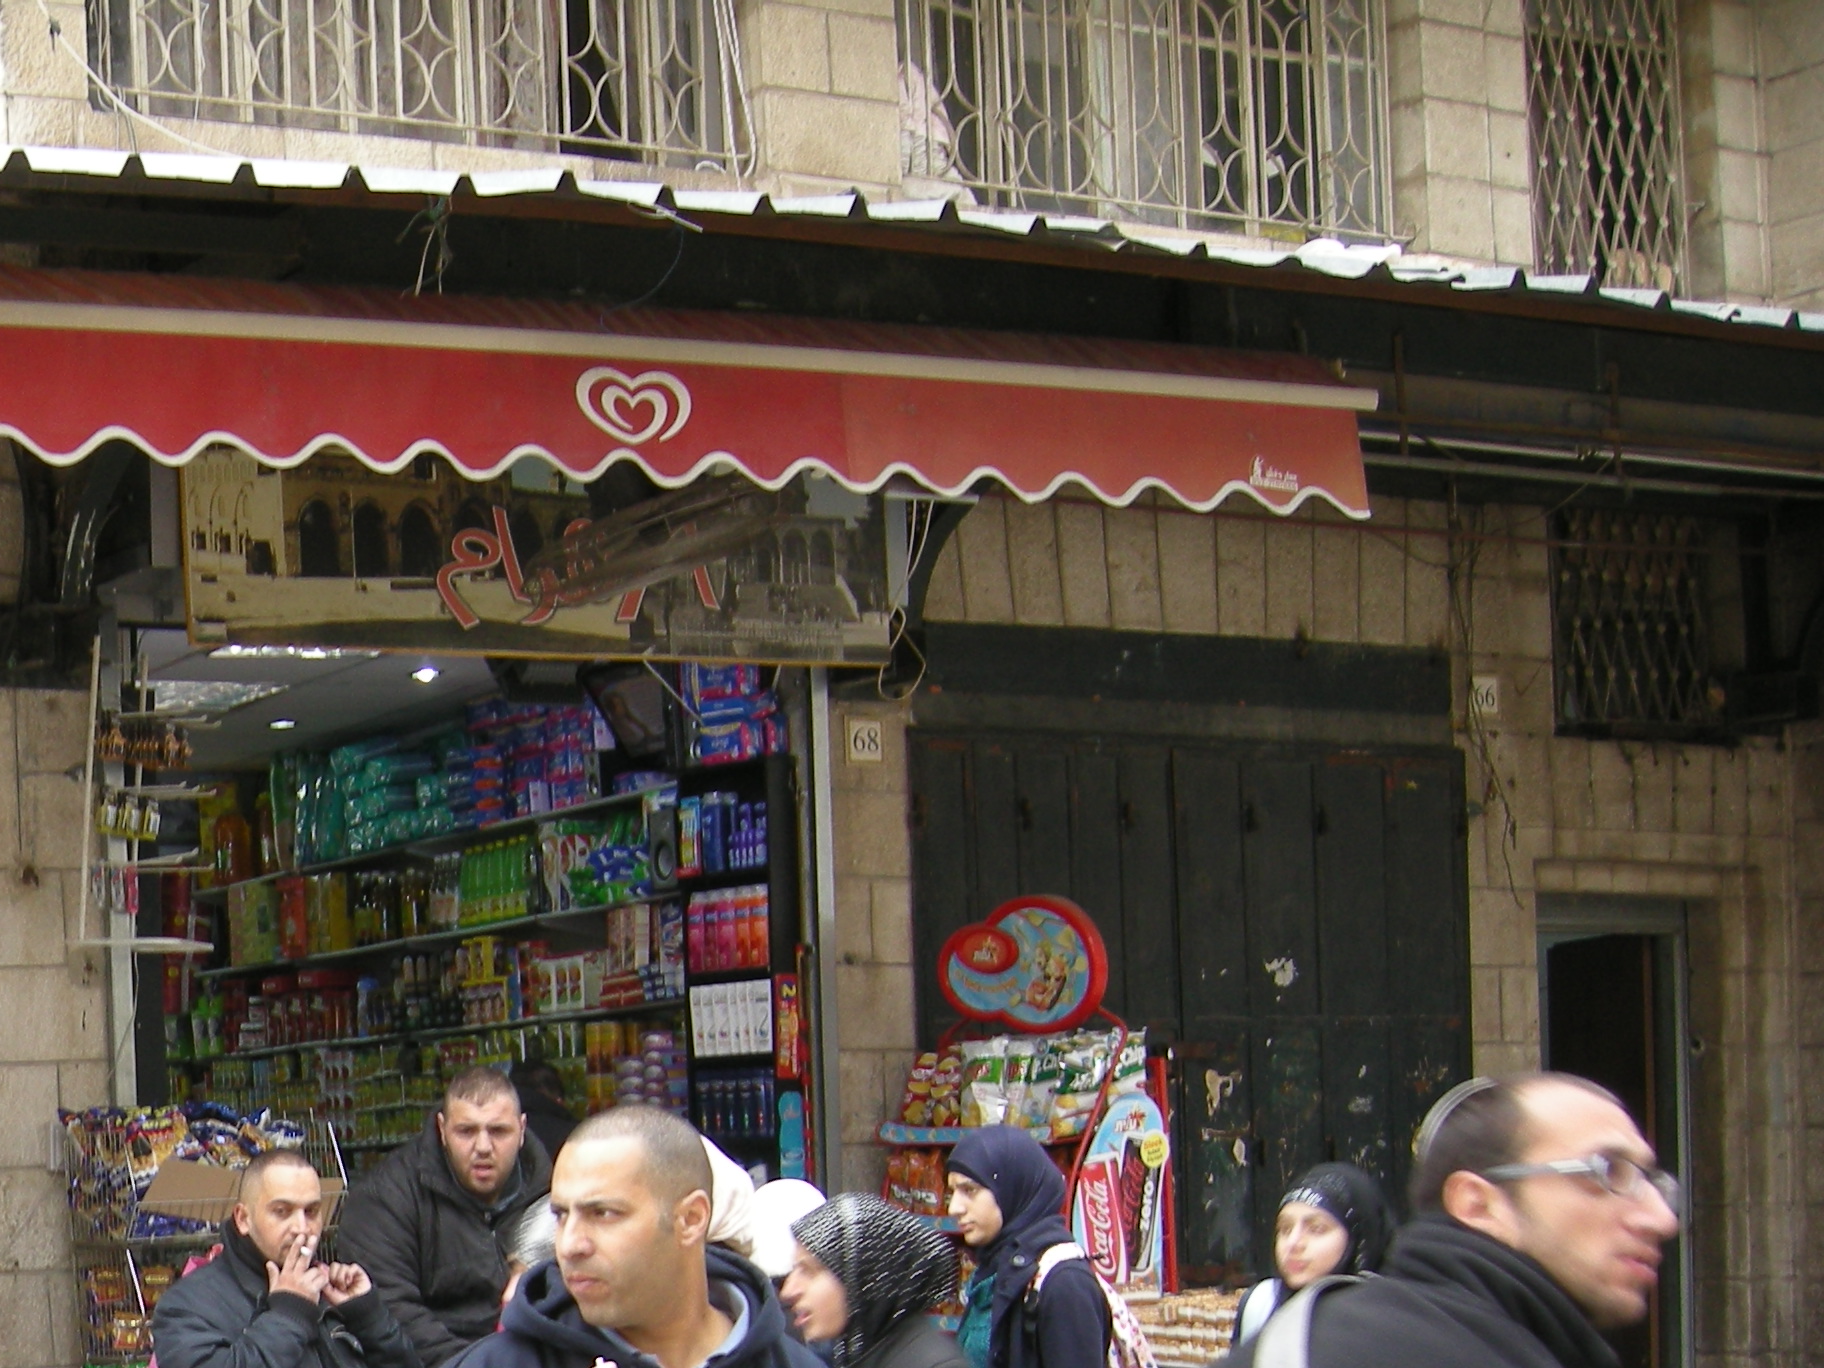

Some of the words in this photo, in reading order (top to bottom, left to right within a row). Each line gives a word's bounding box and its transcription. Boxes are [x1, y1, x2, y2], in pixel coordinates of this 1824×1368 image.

[1476, 684, 1495, 707] 66
[854, 727, 879, 751] 68
[1140, 1179, 1154, 1231] zero
